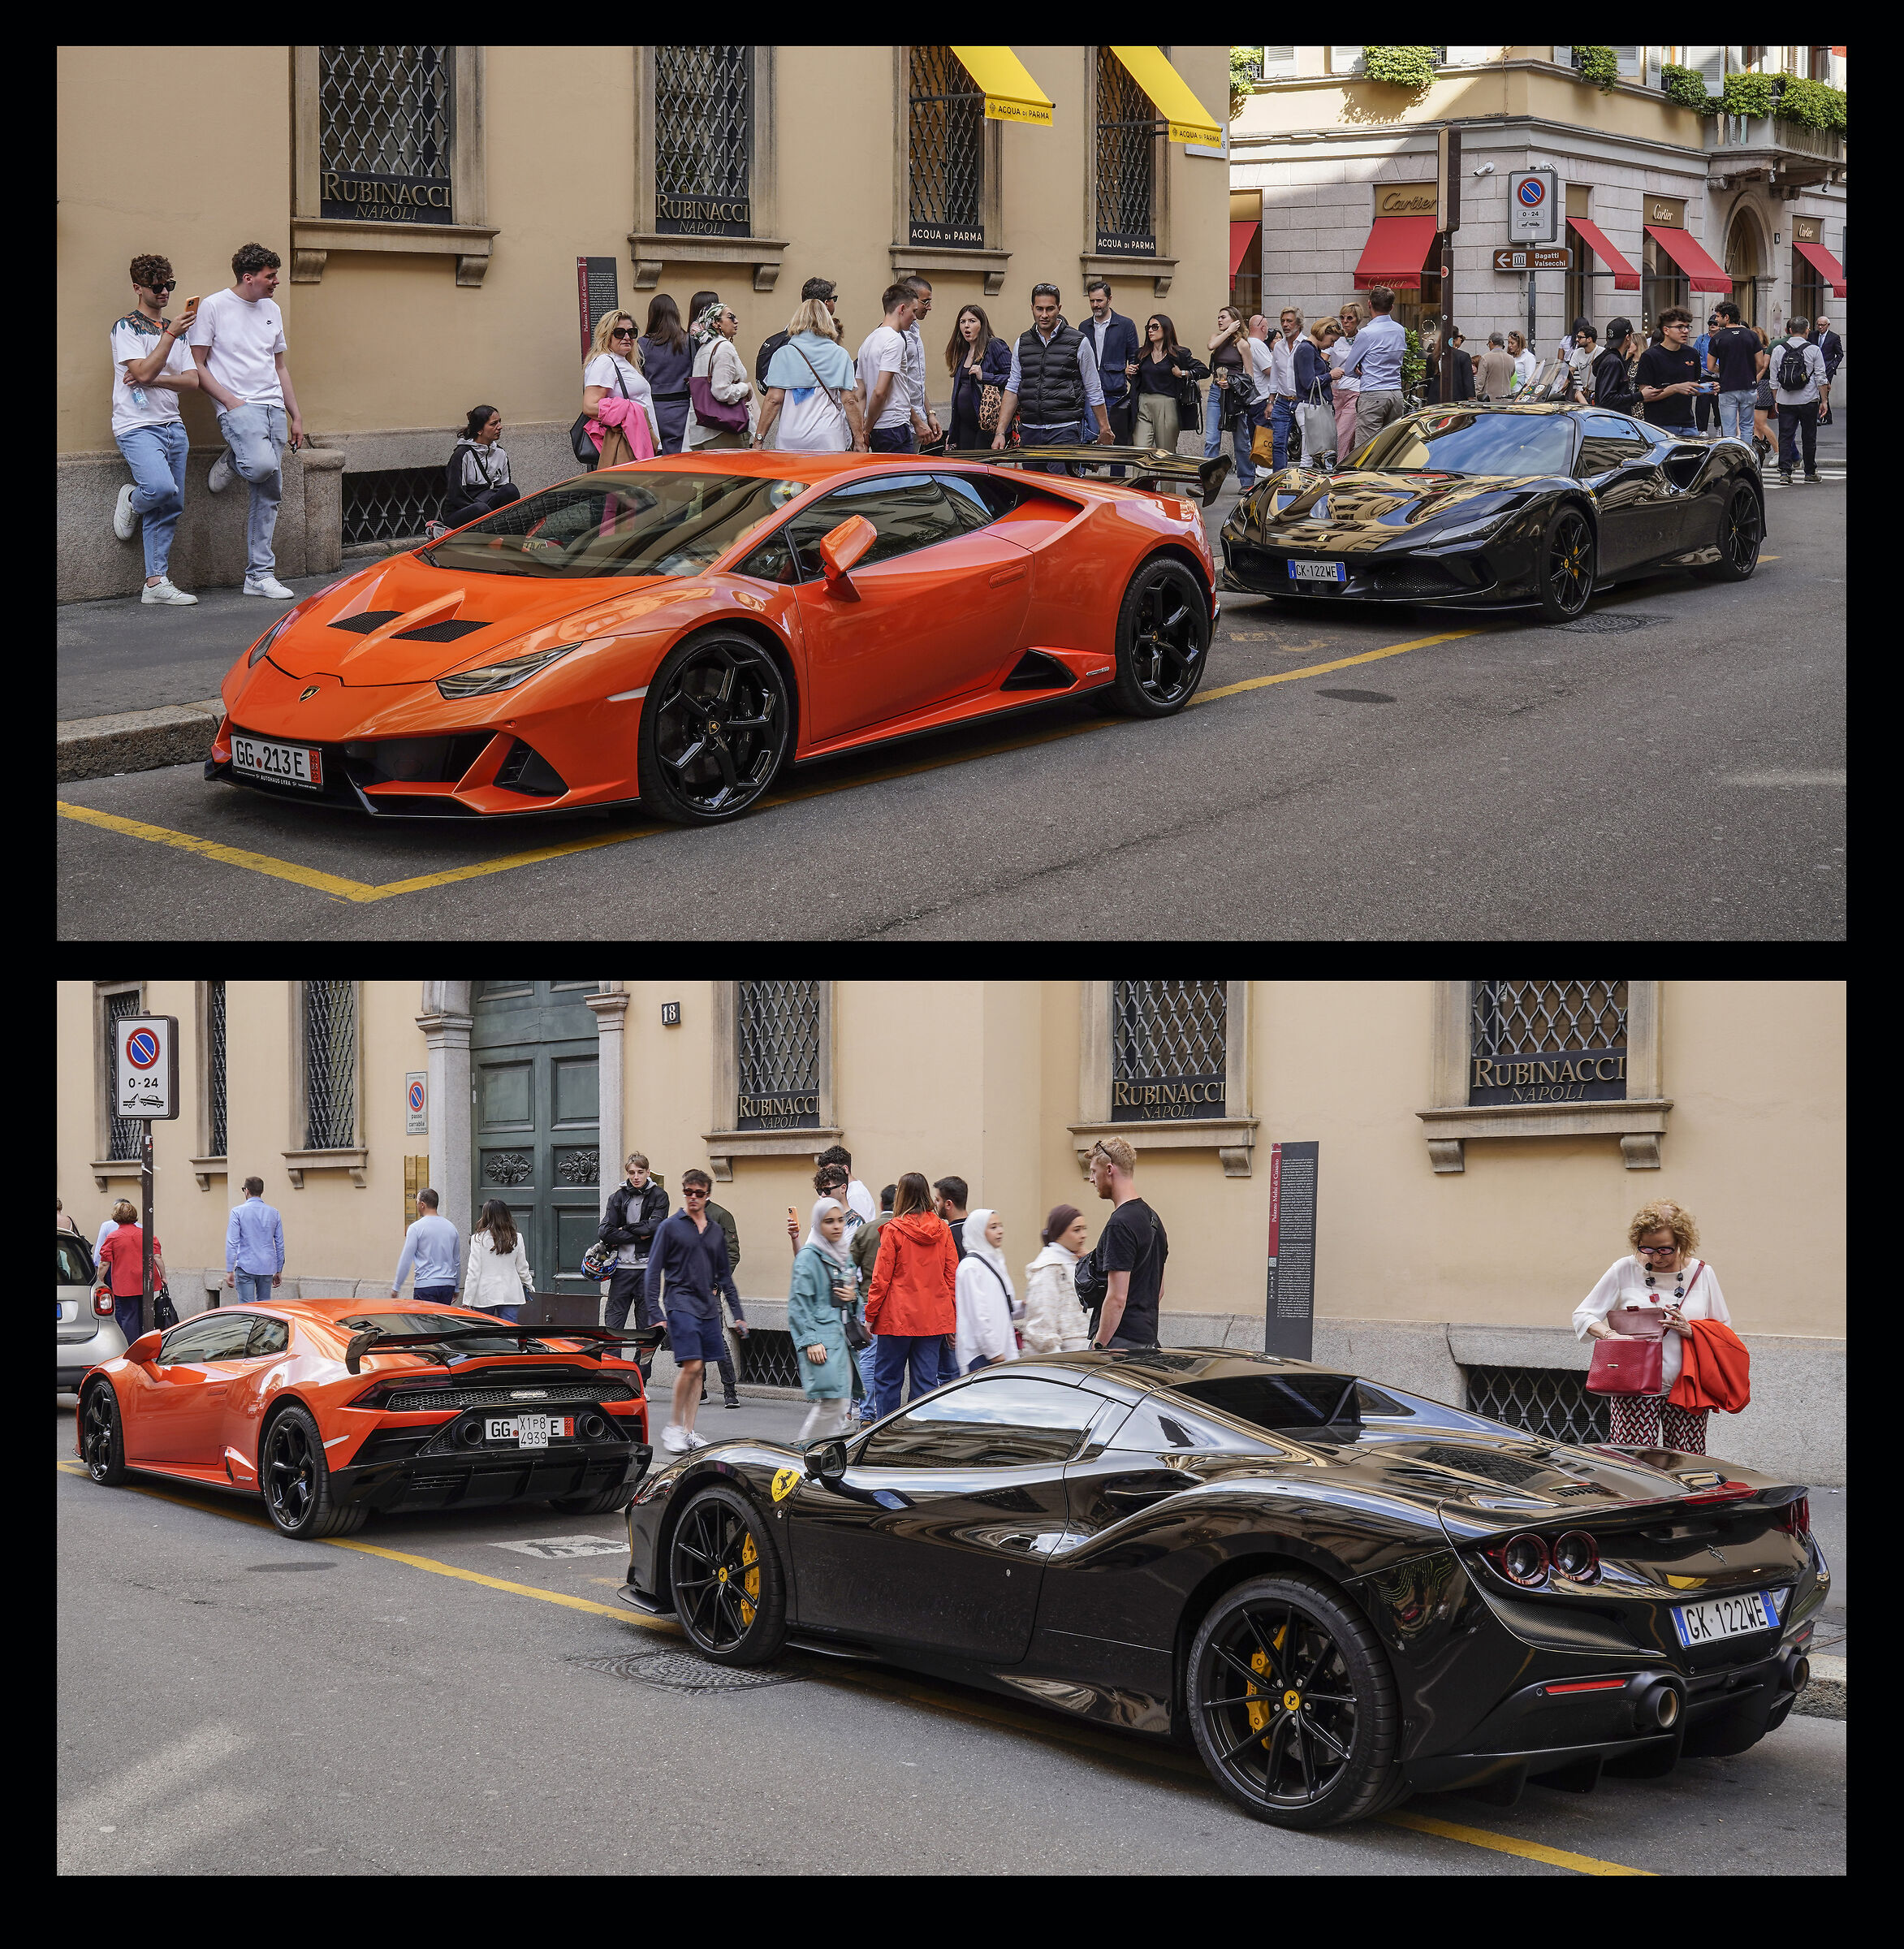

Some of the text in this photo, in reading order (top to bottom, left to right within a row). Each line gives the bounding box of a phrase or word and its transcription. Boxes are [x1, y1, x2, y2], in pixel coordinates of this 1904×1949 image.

[998, 106, 1021, 115] ACQUA
[1029, 110, 1050, 119] PARMA
[1179, 130, 1198, 139] ACQUA
[1203, 133, 1220, 143] PARMA
[322, 171, 451, 208] RUBINACCI
[656, 193, 750, 223] RUBINACCI
[1383, 192, 1437, 211] Cartier
[355, 205, 418, 221] NAPOLI
[1653, 203, 1674, 221] Cartier
[679, 221, 726, 235] NAPOLI
[911, 229, 942, 240] ACQUA
[953, 231, 982, 242] PARMA
[1798, 223, 1814, 238] Cartier
[1098, 239, 1122, 248] ACQUA
[1131, 240, 1155, 250] PARMA
[261, 775, 280, 784] AUTOHAUS
[663, 1005, 676, 1022] 18
[1472, 1057, 1626, 1087] RUBINACCI
[1113, 1081, 1225, 1106] RUBINACCI
[1509, 1084, 1586, 1103] NAPOLI
[738, 1096, 820, 1117] RUBINACCI
[1142, 1104, 1196, 1119] NAPOLI
[759, 1116, 801, 1129] NAPOLI
[520, 1431, 547, 1446] 4939
